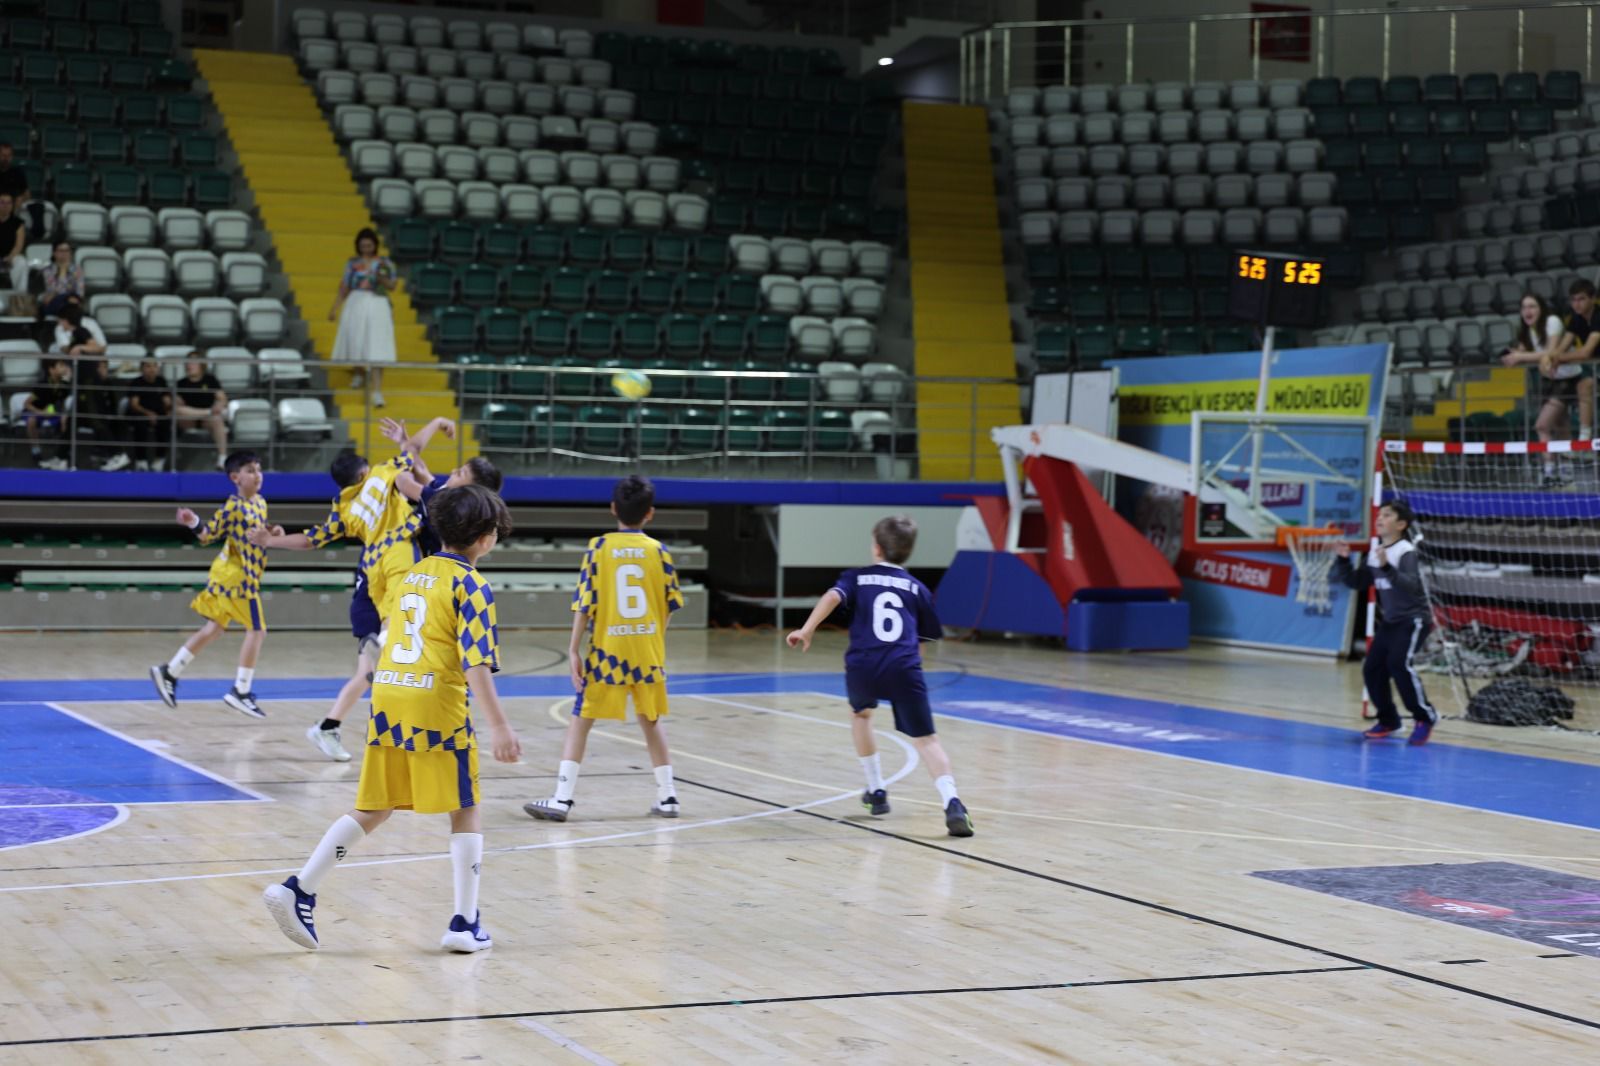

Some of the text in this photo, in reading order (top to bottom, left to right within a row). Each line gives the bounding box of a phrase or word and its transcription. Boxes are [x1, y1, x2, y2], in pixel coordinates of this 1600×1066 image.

[1273, 382, 1364, 410] MÜDÜRLÜĞÜ
[612, 547, 646, 559] MTK
[616, 563, 648, 619] 6
[872, 591, 904, 643] 6
[391, 592, 428, 665] 3
